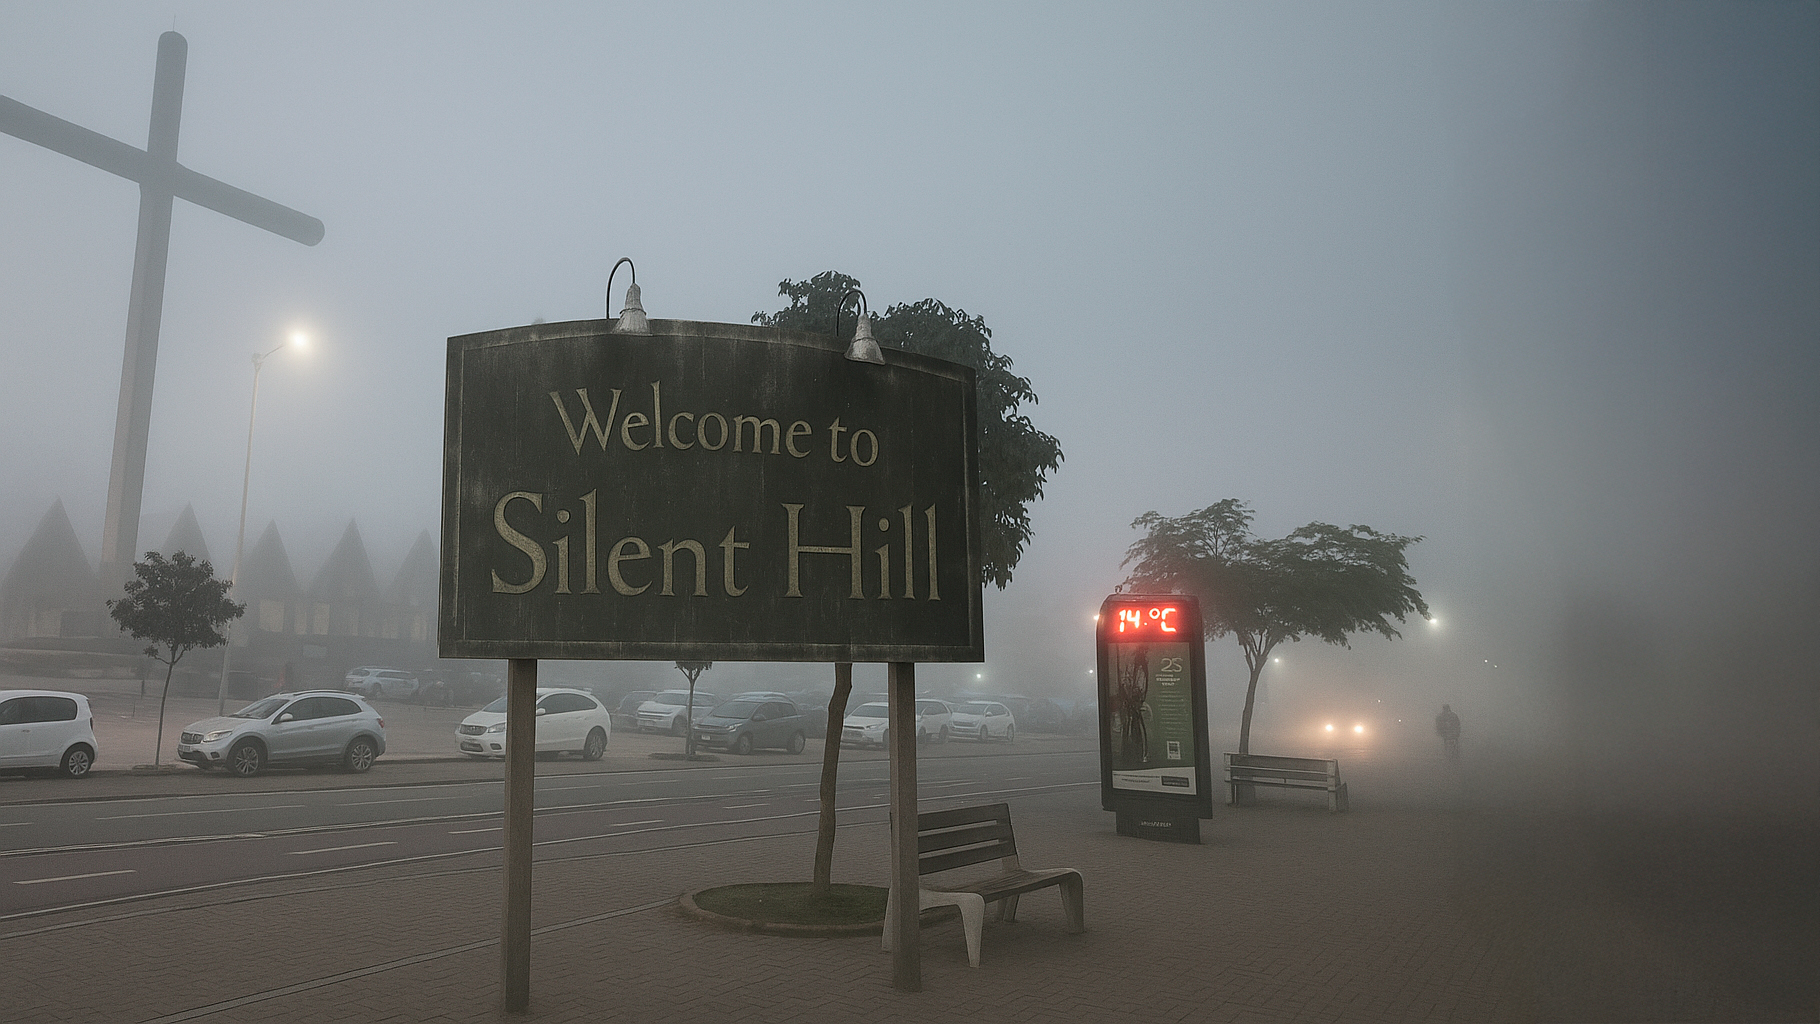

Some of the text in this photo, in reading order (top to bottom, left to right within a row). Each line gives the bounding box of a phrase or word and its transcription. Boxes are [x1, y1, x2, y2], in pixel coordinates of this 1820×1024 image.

[548, 380, 880, 468] Welcome to
[491, 488, 941, 601] Silent Hill
